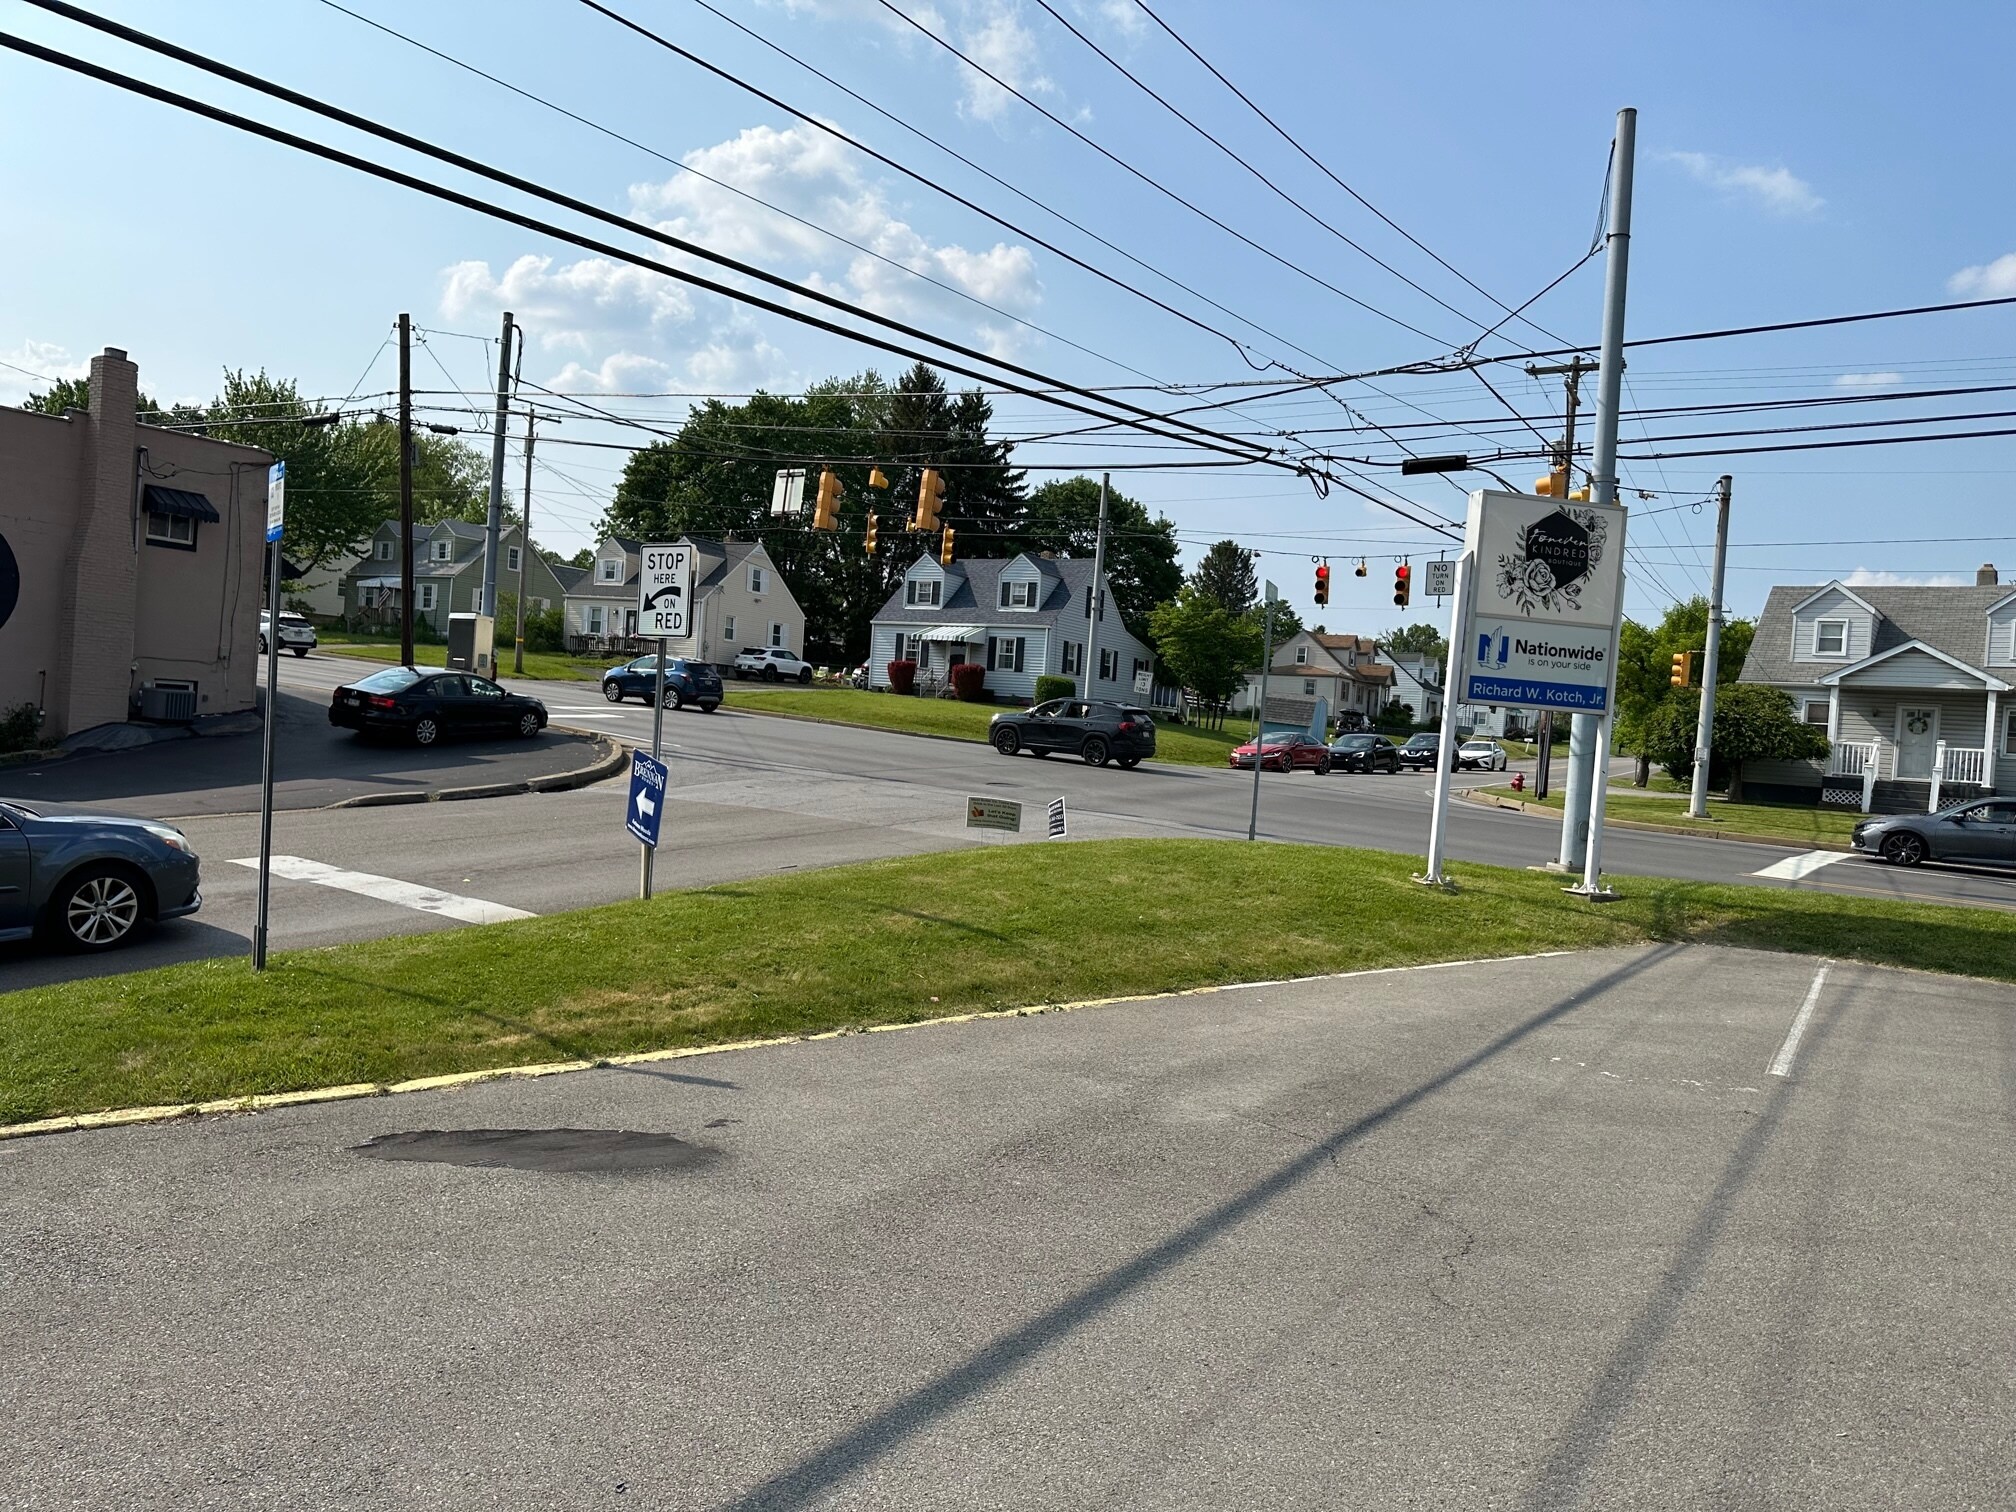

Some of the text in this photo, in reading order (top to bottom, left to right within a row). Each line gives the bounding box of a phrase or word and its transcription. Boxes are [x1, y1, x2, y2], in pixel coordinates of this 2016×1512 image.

[1528, 528, 1588, 546] Forever
[1532, 544, 1586, 559] KINDRED
[648, 553, 684, 570] STOP
[1433, 564, 1448, 572] NO
[1547, 558, 1582, 567] BOUTIQUE
[653, 573, 676, 584] HERE
[664, 598, 676, 609] ON
[655, 612, 682, 630] RED
[1515, 639, 1604, 661] Nationwide
[1528, 658, 1535, 666] is
[1551, 661, 1571, 670] your
[1573, 661, 1592, 671] side
[1473, 682, 1604, 705] Richard W. Kotch, Jr.
[634, 760, 665, 791] BRENNAN
